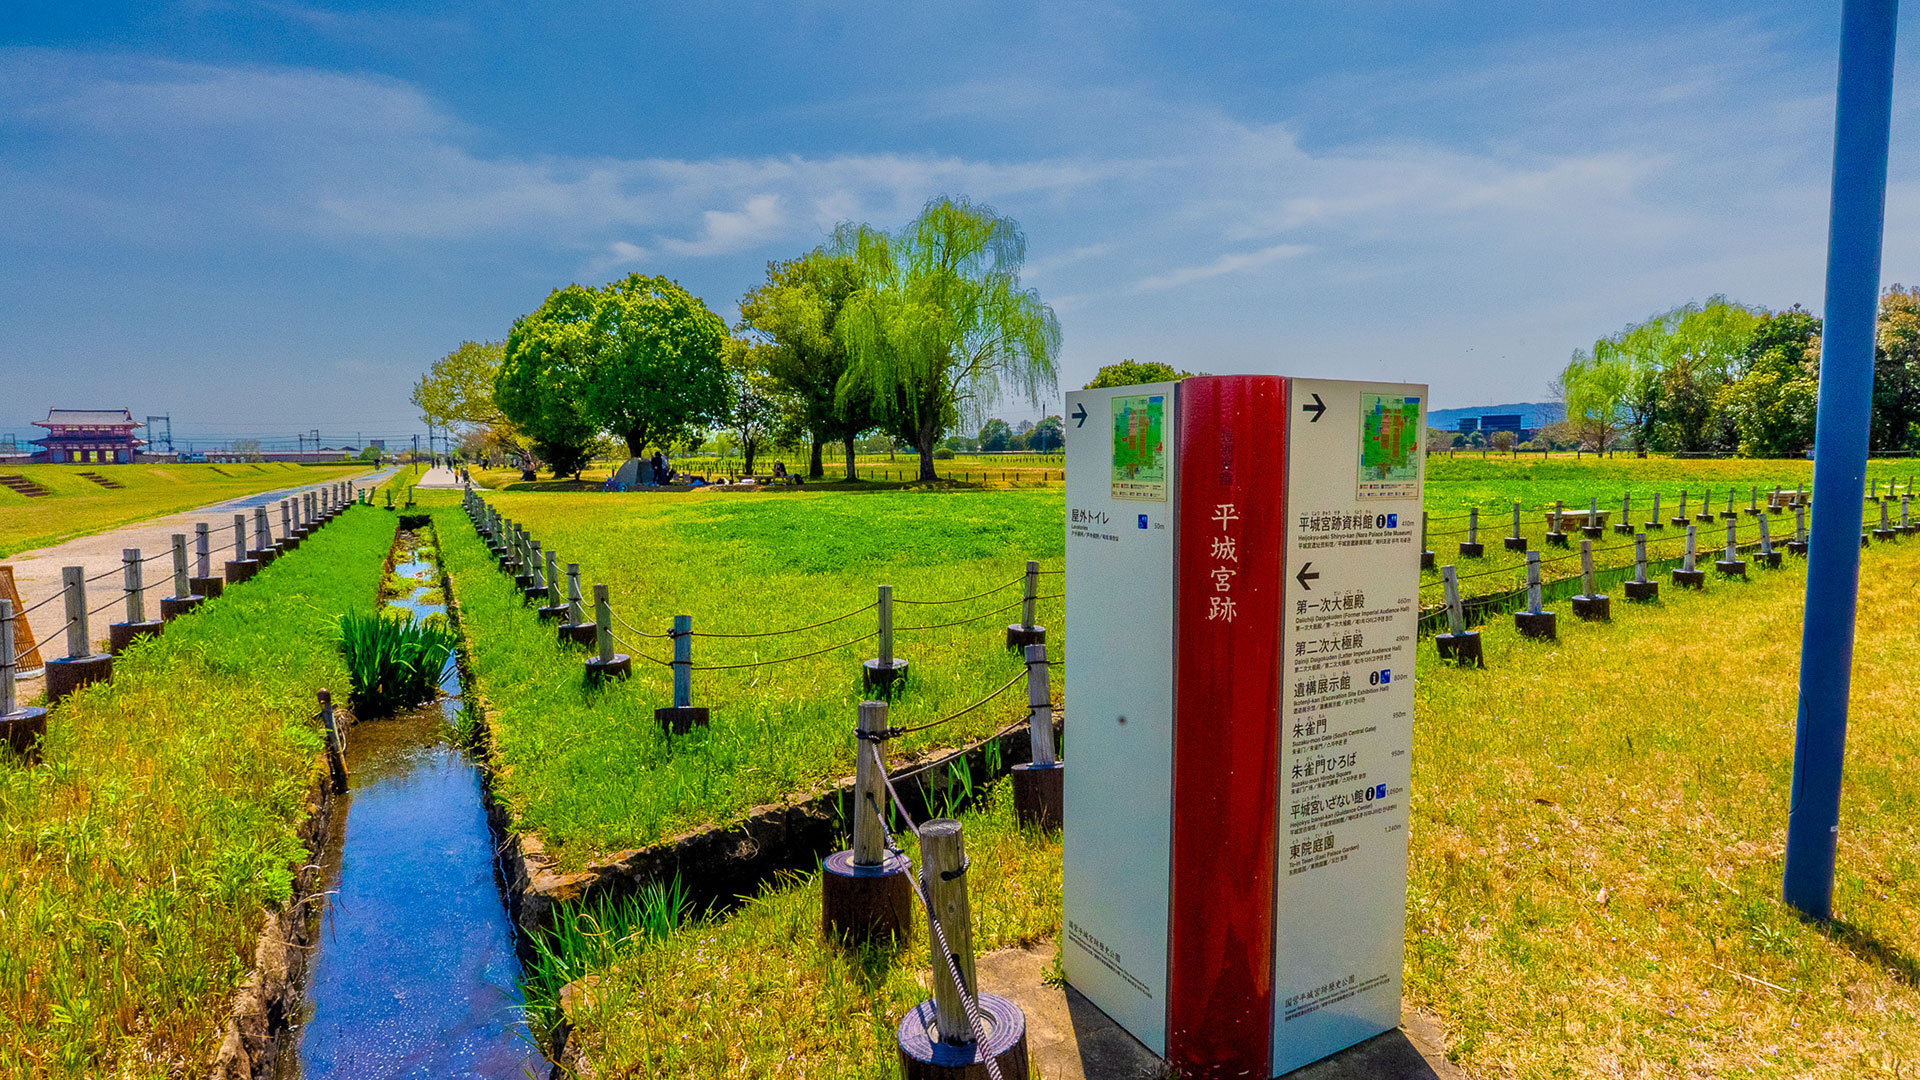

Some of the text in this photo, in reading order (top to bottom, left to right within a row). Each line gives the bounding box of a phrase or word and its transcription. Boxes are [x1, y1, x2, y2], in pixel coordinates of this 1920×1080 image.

[1071, 508, 1110, 524] 屋外トイレ
[1298, 514, 1374, 532] 平城宮跡資料館
[1154, 522, 1165, 530] 50m
[1208, 503, 1239, 623] 平城宮跡
[1295, 594, 1365, 615] 第一次大極殿
[1379, 607, 1400, 615] Audience
[1294, 633, 1364, 657] 第二次大極殿
[1371, 647, 1392, 655] Audience
[1293, 675, 1351, 699] 遺構展示館
[1392, 711, 1407, 719] 950m
[1292, 718, 1327, 739] 朱雀門
[1348, 727, 1364, 736] Central
[1291, 751, 1358, 780] 朱雀門ひろば
[1335, 770, 1352, 779] Square
[1290, 789, 1364, 820] 平城宮いざない館
[1289, 834, 1335, 860] 東院庭園
[1326, 849, 1342, 859] Palace
